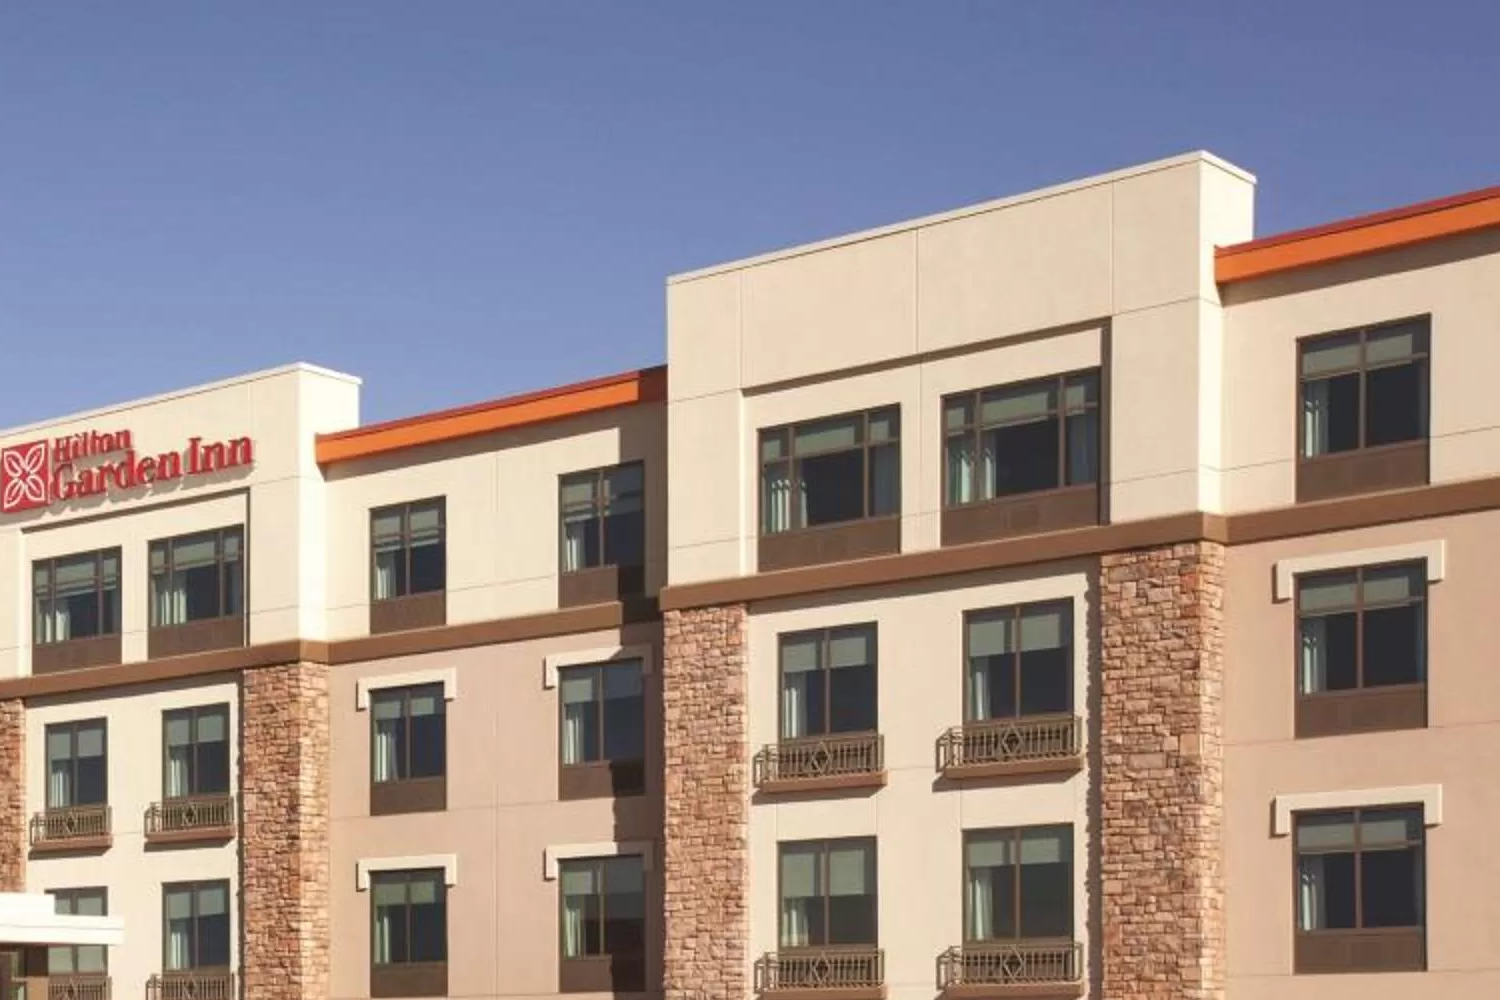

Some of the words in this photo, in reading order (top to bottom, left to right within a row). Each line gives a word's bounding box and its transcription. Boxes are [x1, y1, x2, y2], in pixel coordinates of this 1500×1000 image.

[53, 449, 182, 500] Garden
[187, 436, 253, 475] Inn
[54, 429, 131, 462] Hilton
